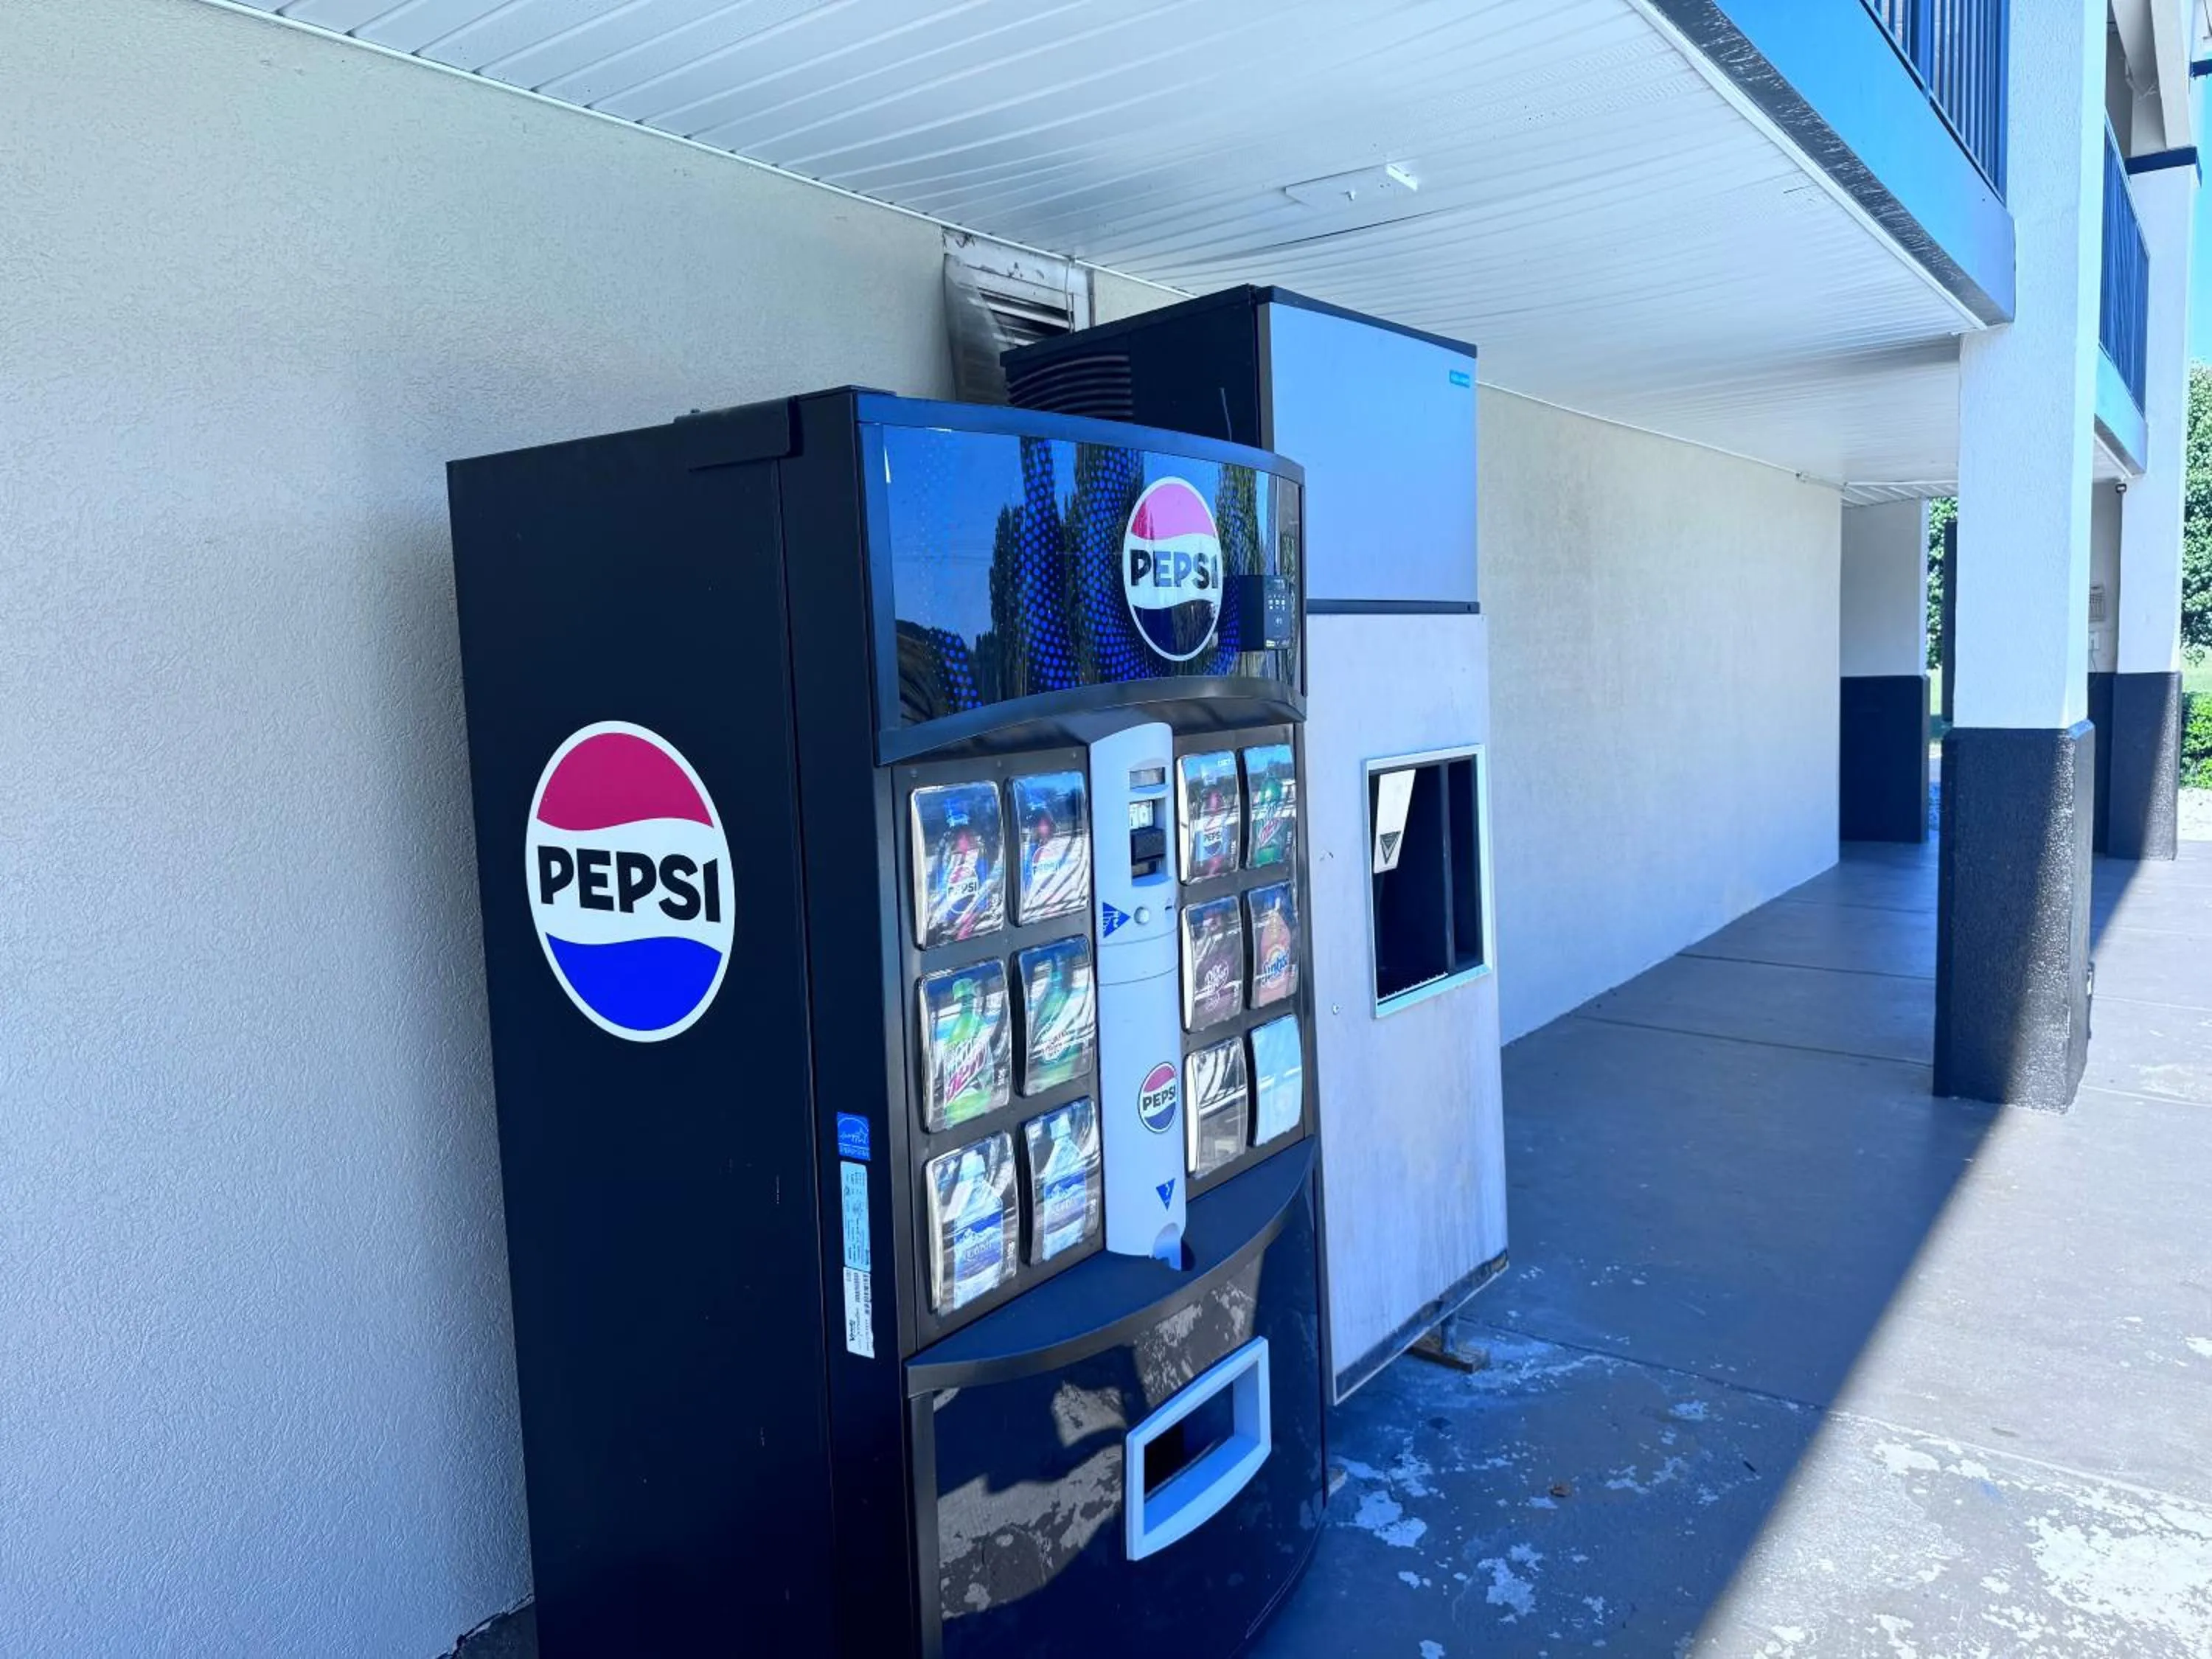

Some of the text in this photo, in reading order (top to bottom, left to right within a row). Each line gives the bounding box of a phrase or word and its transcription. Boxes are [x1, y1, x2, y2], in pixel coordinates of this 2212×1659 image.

[1130, 549, 1219, 590] PEPSI
[537, 845, 722, 923] PEPSI
[948, 881, 977, 897] PPSI
[1143, 1084, 1176, 1111] PEPSI
